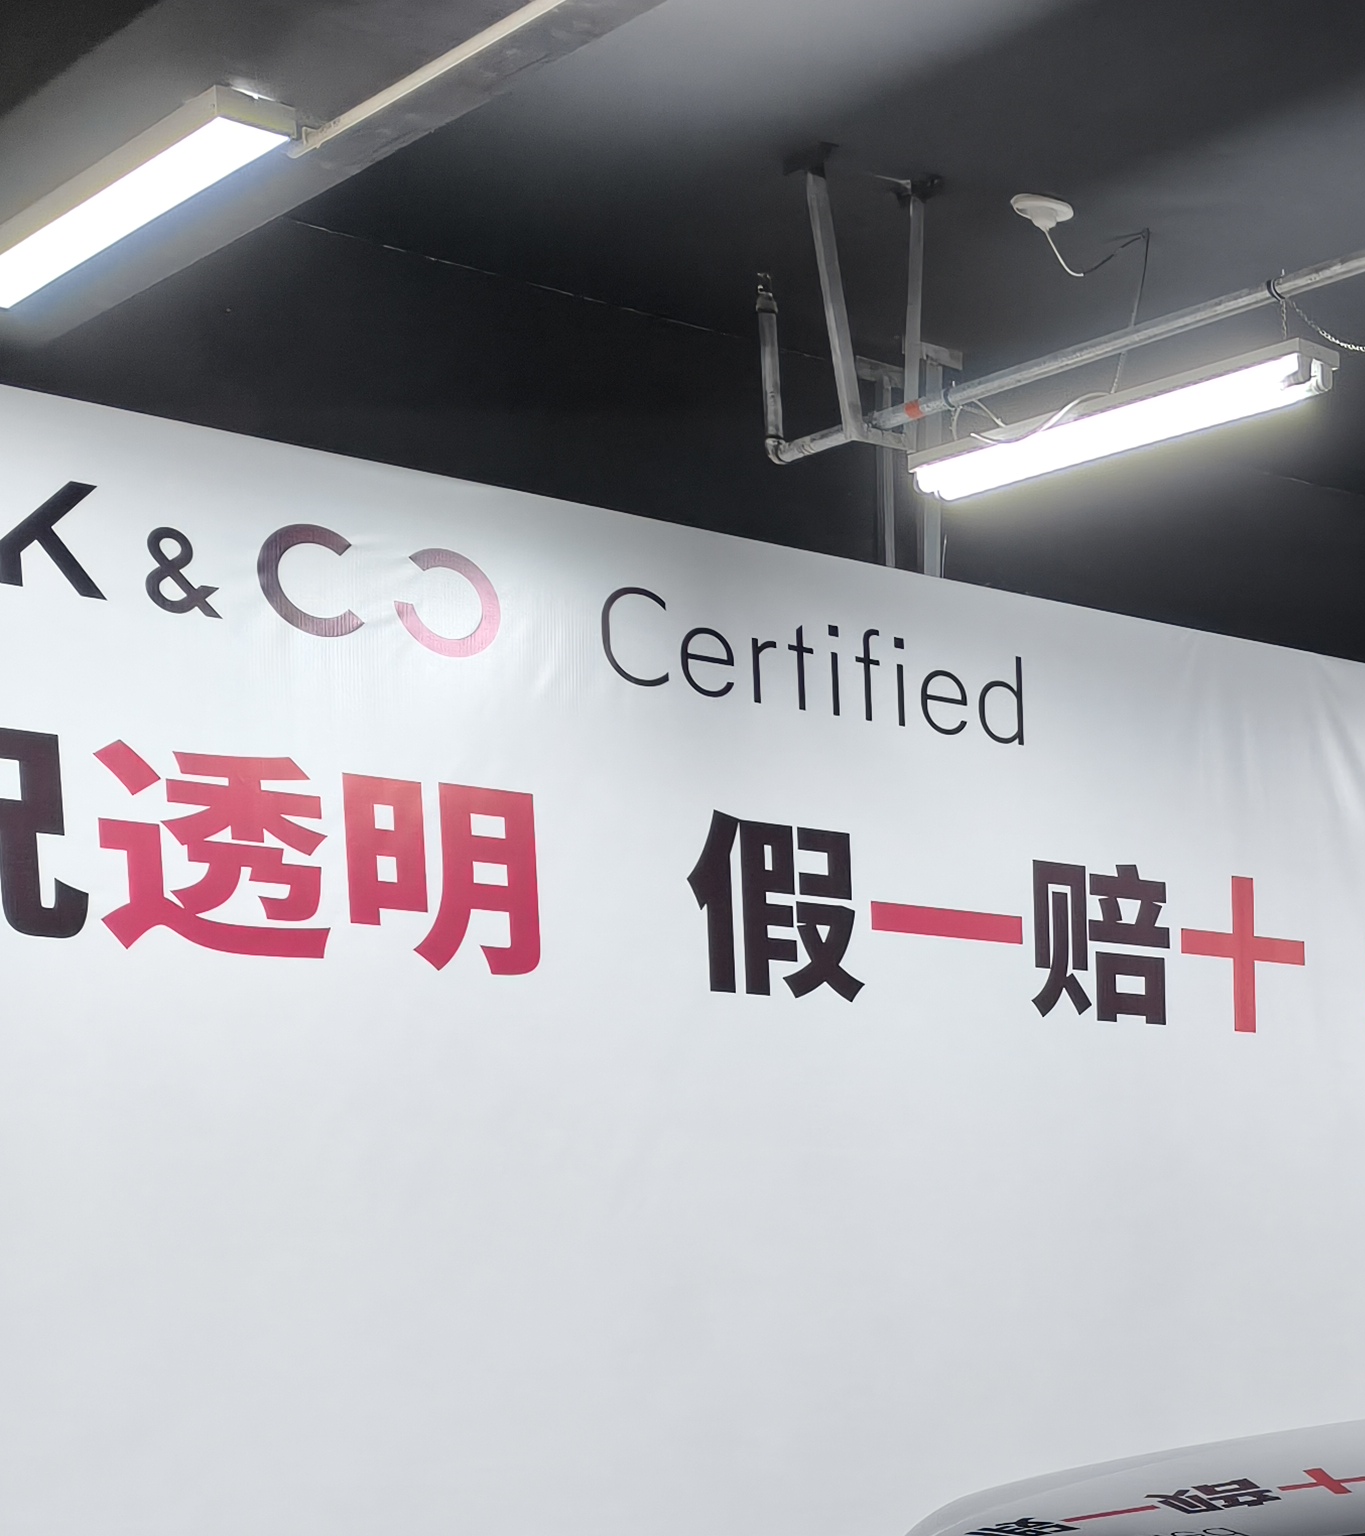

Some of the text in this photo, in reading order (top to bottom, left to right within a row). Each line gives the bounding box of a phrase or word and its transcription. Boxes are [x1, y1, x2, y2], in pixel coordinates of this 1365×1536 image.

[600, 587, 1025, 746] Certified
[687, 810, 1306, 1033] 假一赔十
